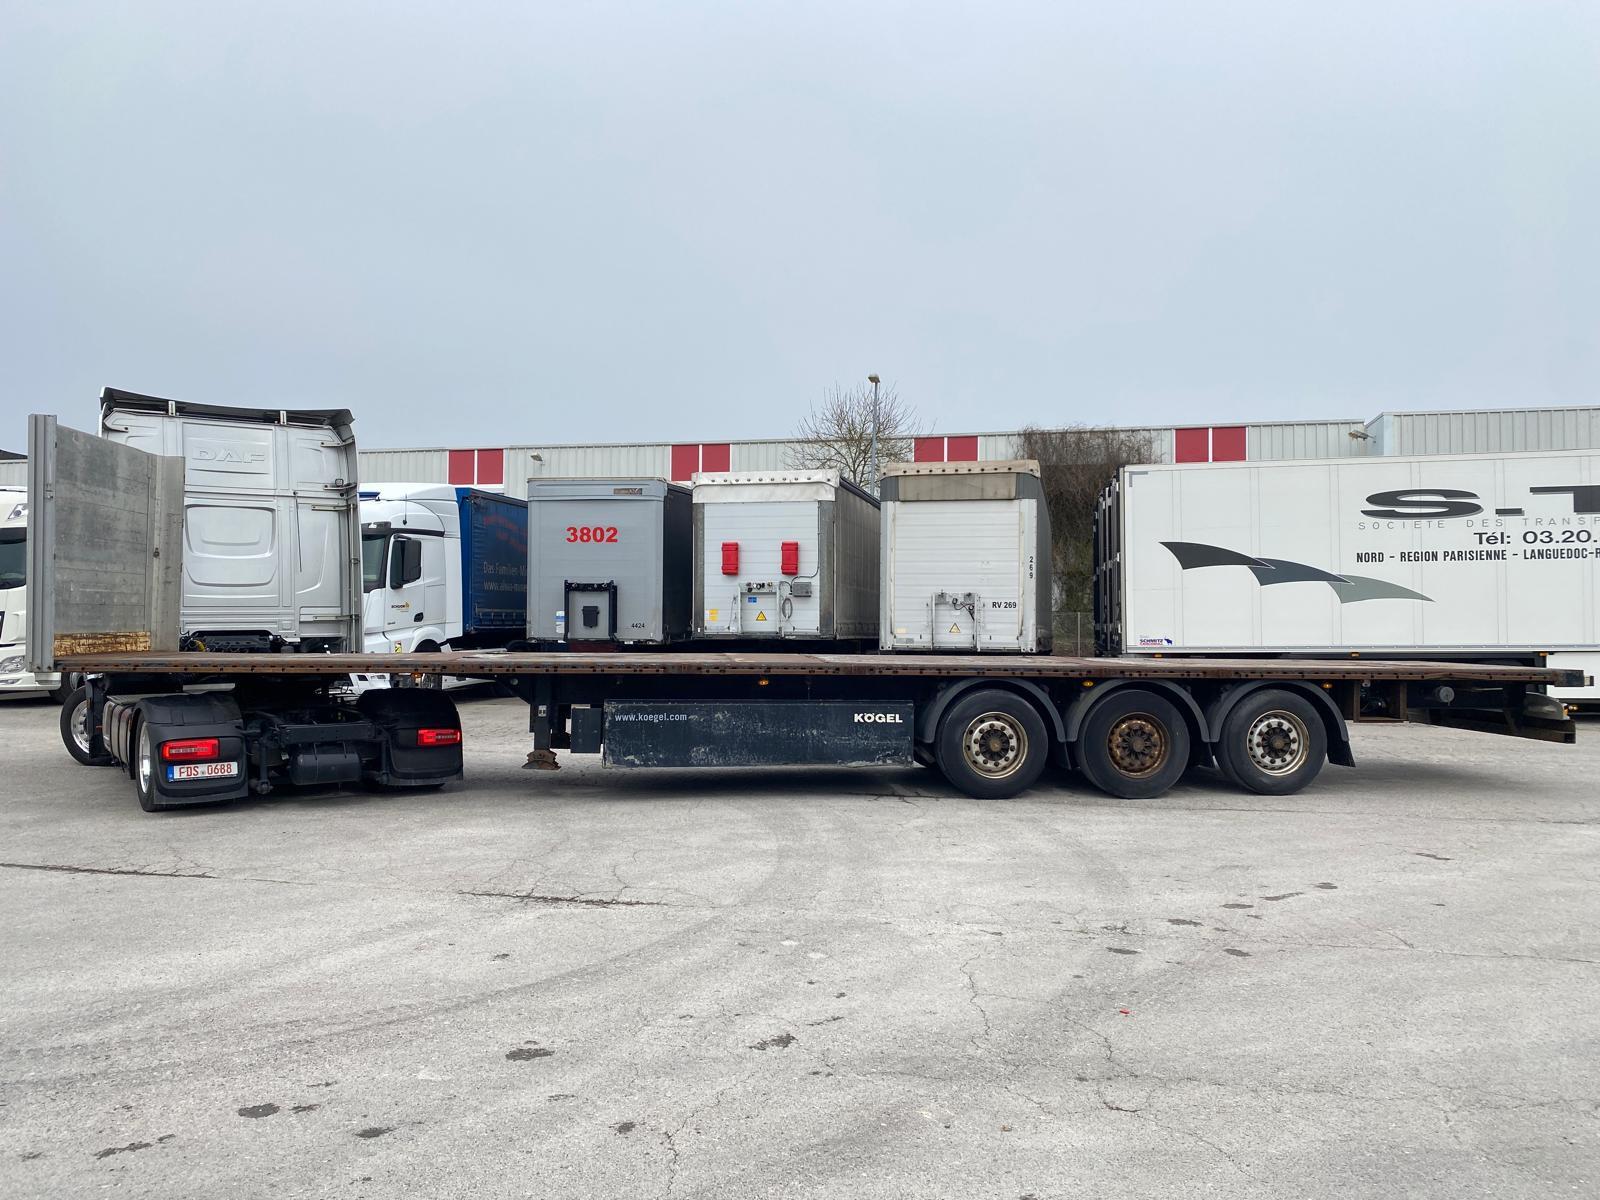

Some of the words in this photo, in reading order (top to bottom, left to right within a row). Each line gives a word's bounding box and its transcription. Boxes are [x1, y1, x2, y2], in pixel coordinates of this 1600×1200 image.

[192, 448, 266, 463] DAF
[1358, 519, 1446, 531] SOCIETE
[1466, 518, 1504, 528] DES
[566, 526, 618, 543] 3802
[1473, 531, 1511, 545] Tél:
[1356, 552, 1385, 563] NORD
[1400, 551, 1438, 562] REGION
[1443, 549, 1508, 562] PARISIENNE
[992, 601, 1003, 609] RV
[1003, 601, 1017, 609] 269
[614, 712, 687, 723] www.koegel.com
[853, 712, 903, 723] KÖGEL
[178, 765, 199, 778] FDS
[207, 763, 232, 776] 0688
